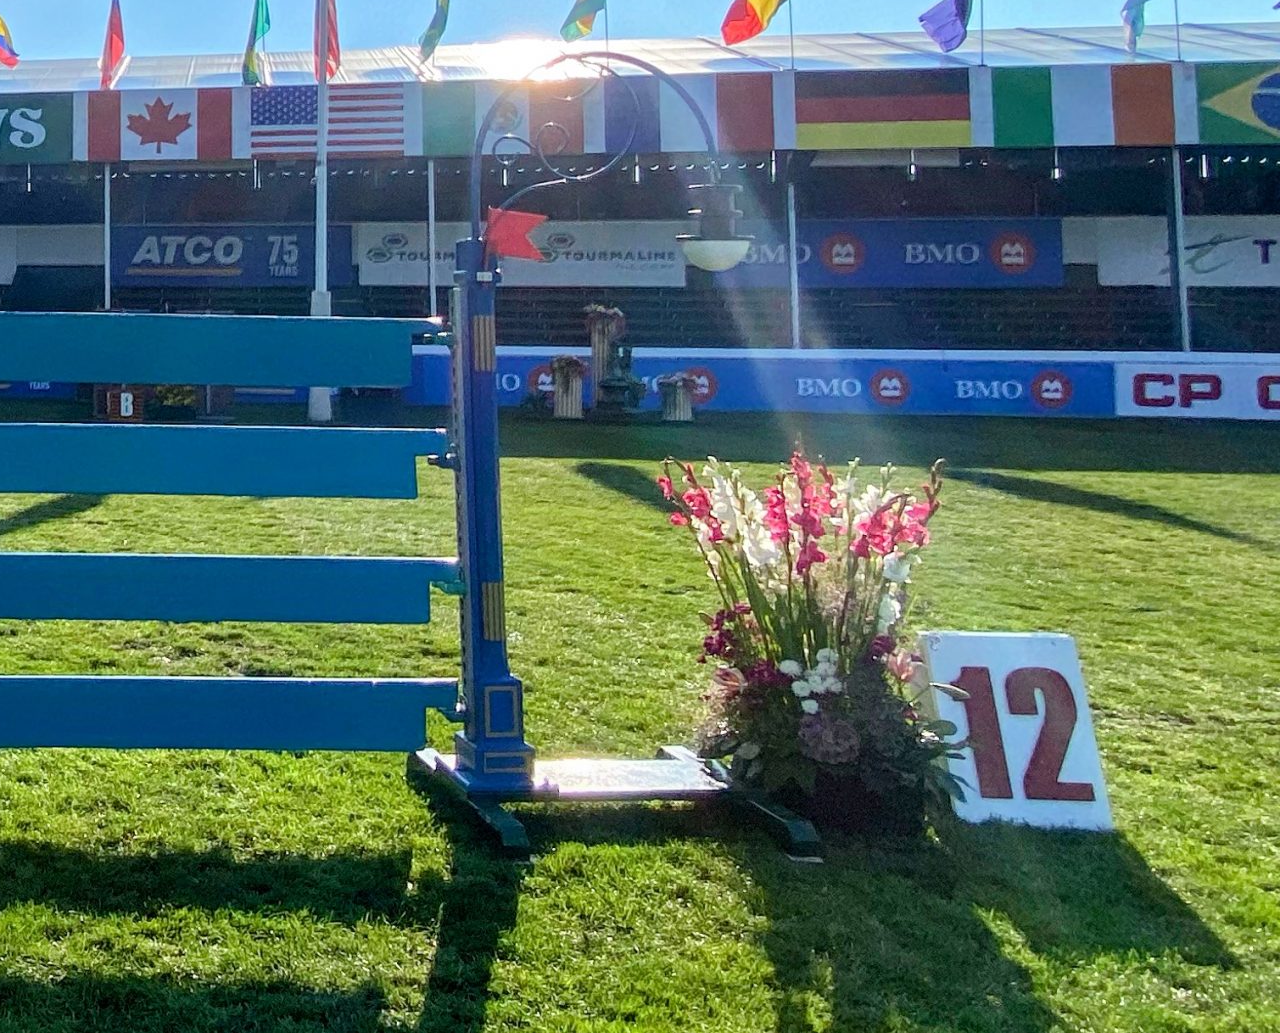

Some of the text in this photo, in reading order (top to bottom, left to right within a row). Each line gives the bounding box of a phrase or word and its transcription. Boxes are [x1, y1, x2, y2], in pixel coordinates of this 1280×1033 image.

[131, 235, 298, 265] ATCO 75
[396, 251, 456, 262] TOURM
[563, 250, 676, 262] TOURMALINE
[904, 243, 980, 264] BMO
[795, 377, 863, 398] BMO
[954, 379, 1023, 400] BMO
[1133, 373, 1222, 408] CP
[1257, 375, 1280, 410] C
[949, 666, 1097, 802] 12
